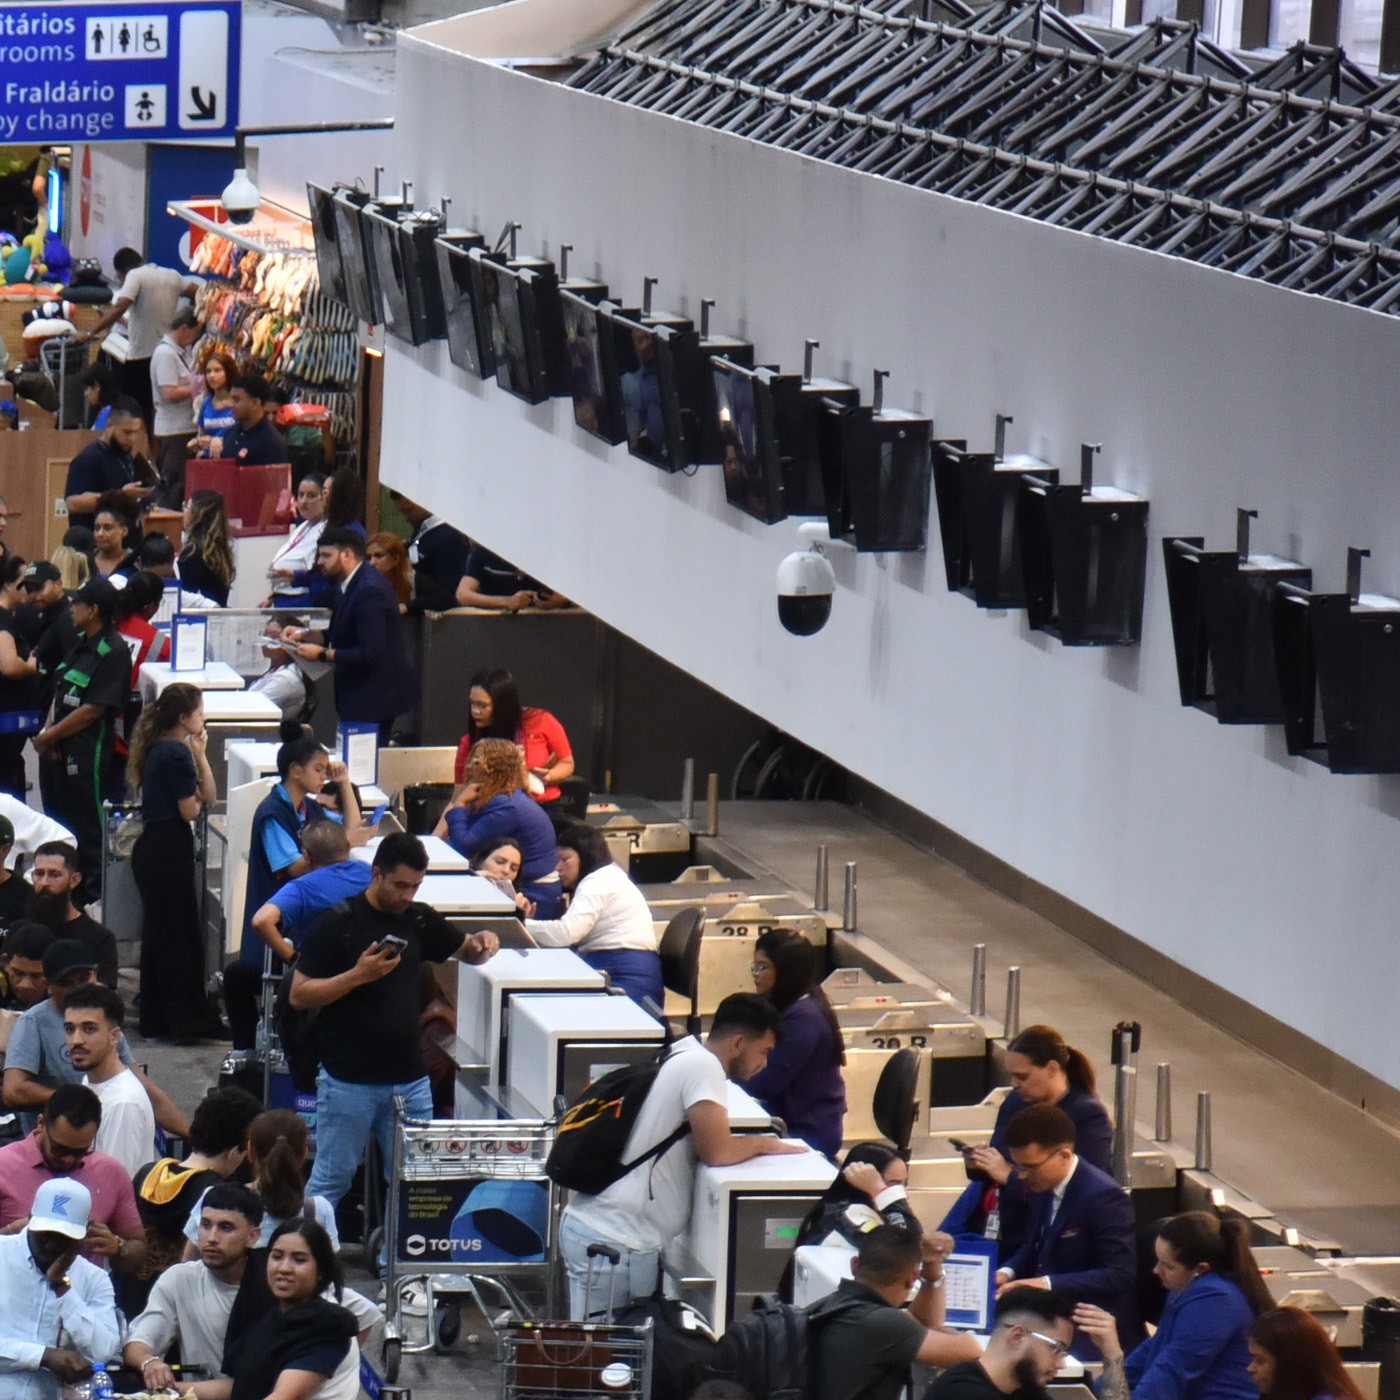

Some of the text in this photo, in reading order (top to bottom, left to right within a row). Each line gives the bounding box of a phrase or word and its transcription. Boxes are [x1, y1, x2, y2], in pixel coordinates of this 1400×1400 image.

[6, 80, 114, 103] Fraldário
[26, 108, 114, 136] change
[52, 1195, 71, 1216] K
